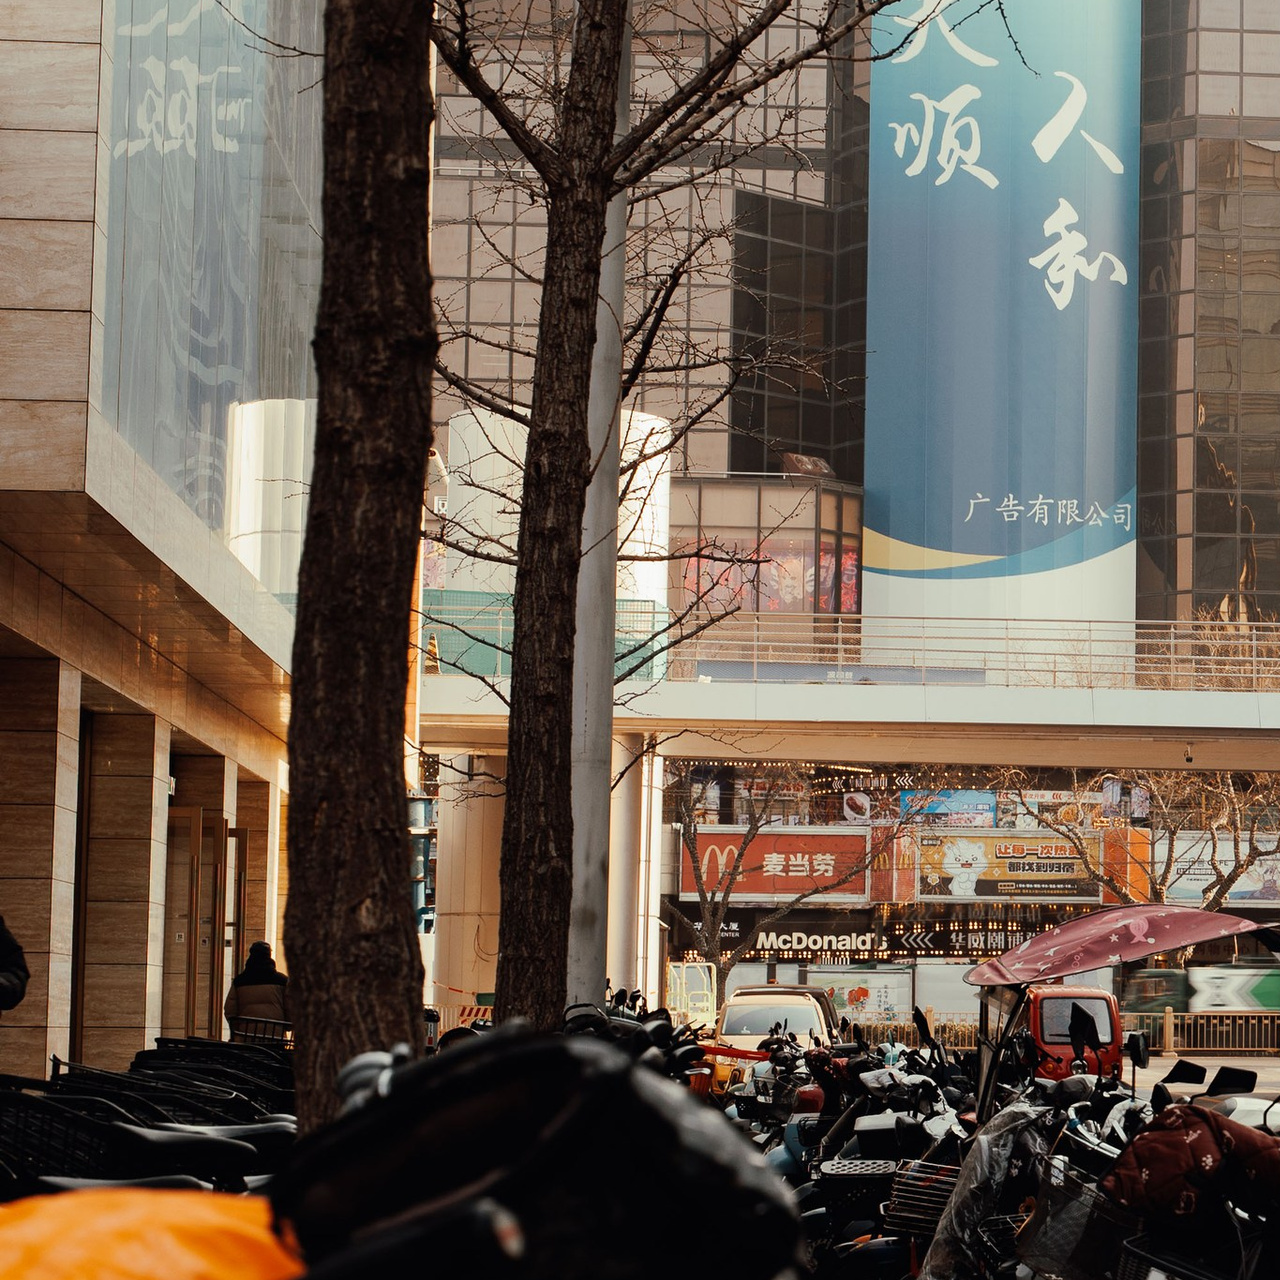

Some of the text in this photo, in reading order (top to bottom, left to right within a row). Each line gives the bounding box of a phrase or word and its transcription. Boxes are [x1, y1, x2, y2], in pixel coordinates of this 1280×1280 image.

[1027, 70, 1129, 312] 人和
[963, 491, 1133, 533] 广告有限公司
[761, 852, 837, 878] 麦当劳
[693, 921, 740, 931] 华大厦
[720, 931, 741, 939] ENTER
[756, 930, 888, 951] McDonald's
